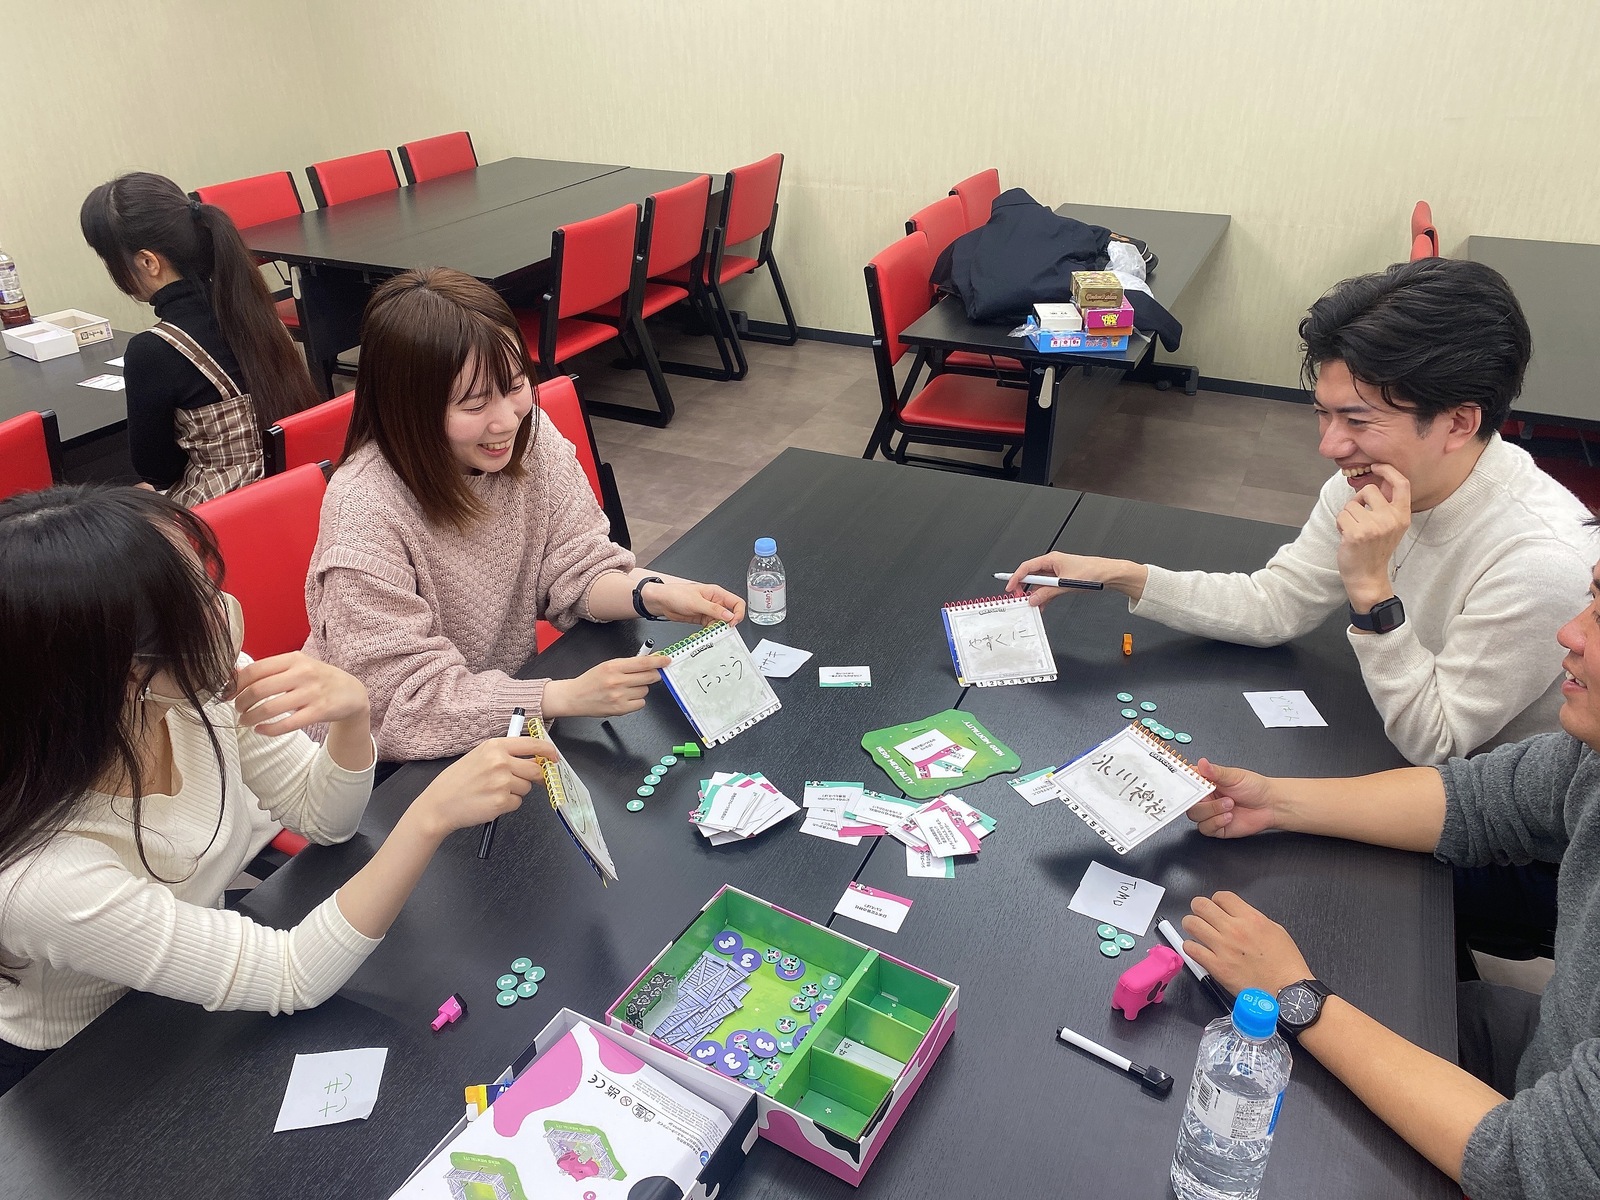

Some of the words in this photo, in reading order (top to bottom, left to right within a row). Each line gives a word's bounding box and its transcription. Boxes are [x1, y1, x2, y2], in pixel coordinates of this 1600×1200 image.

[696, 656, 743, 694] にっこう
[962, 720, 991, 745] MENTALITY
[887, 758, 916, 786] MENTALITY
[1092, 754, 1166, 821] 氷川神社
[718, 936, 736, 949] 3
[740, 953, 755, 968] 3
[696, 1046, 716, 1059] 3
[755, 1038, 775, 1052] 3
[723, 1052, 742, 1070] 3
[318, 1072, 353, 1118] さき
